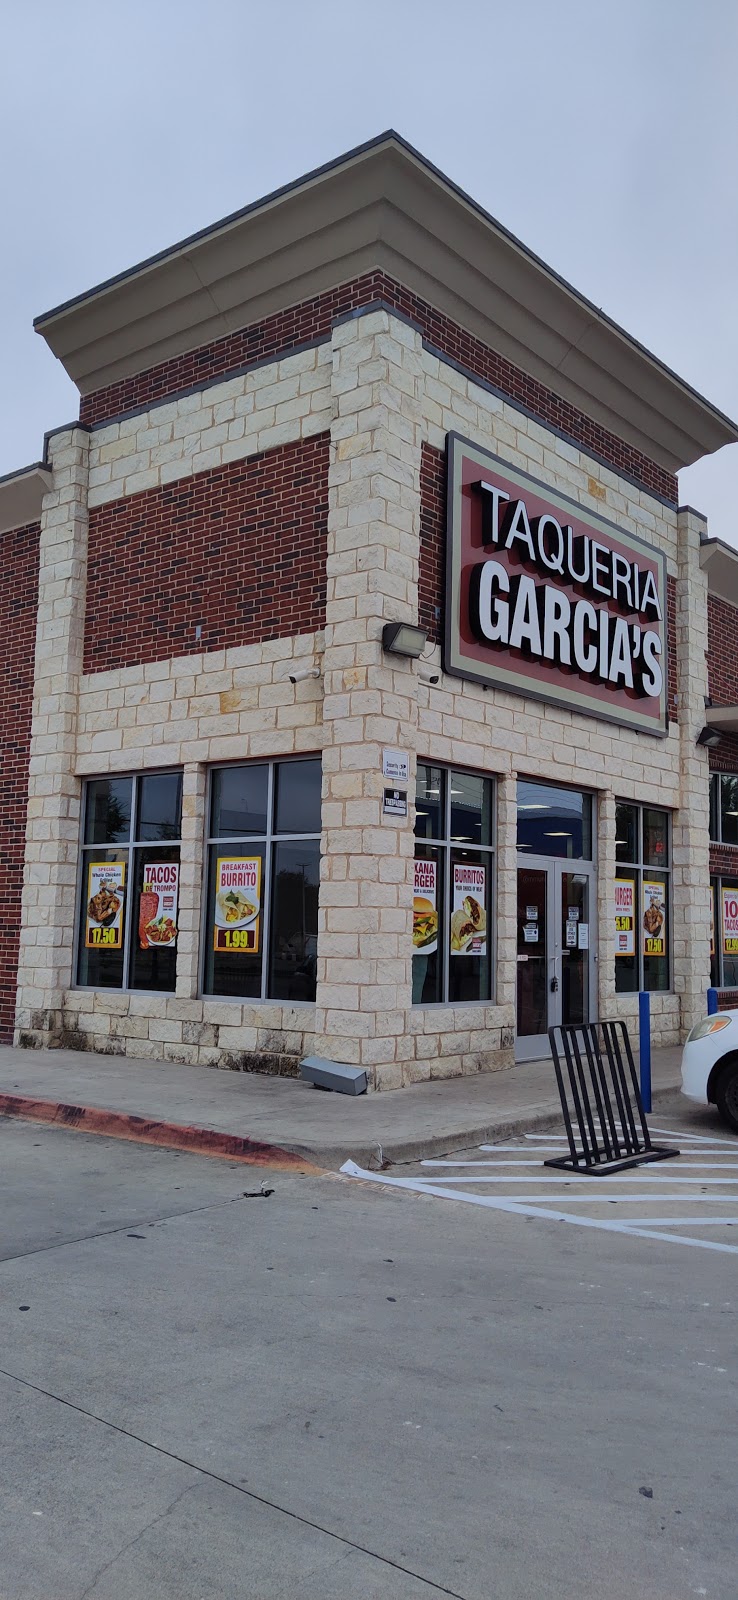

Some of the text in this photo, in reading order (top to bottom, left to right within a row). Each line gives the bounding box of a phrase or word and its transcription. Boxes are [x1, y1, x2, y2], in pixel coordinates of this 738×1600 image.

[480, 479, 663, 622] TAQUERIA
[478, 559, 664, 698] GARCIA'S
[393, 790, 400, 800] NO
[221, 862, 257, 871] BREAKFAST
[145, 866, 177, 884] TACOS
[220, 871, 257, 887] BURRITO
[414, 874, 435, 888] RGER
[454, 868, 484, 885] BURRITOS
[154, 884, 177, 892] TROMPO
[91, 927, 116, 944] 17.50
[224, 930, 248, 948] 1.99
[646, 938, 662, 953] 17.50
